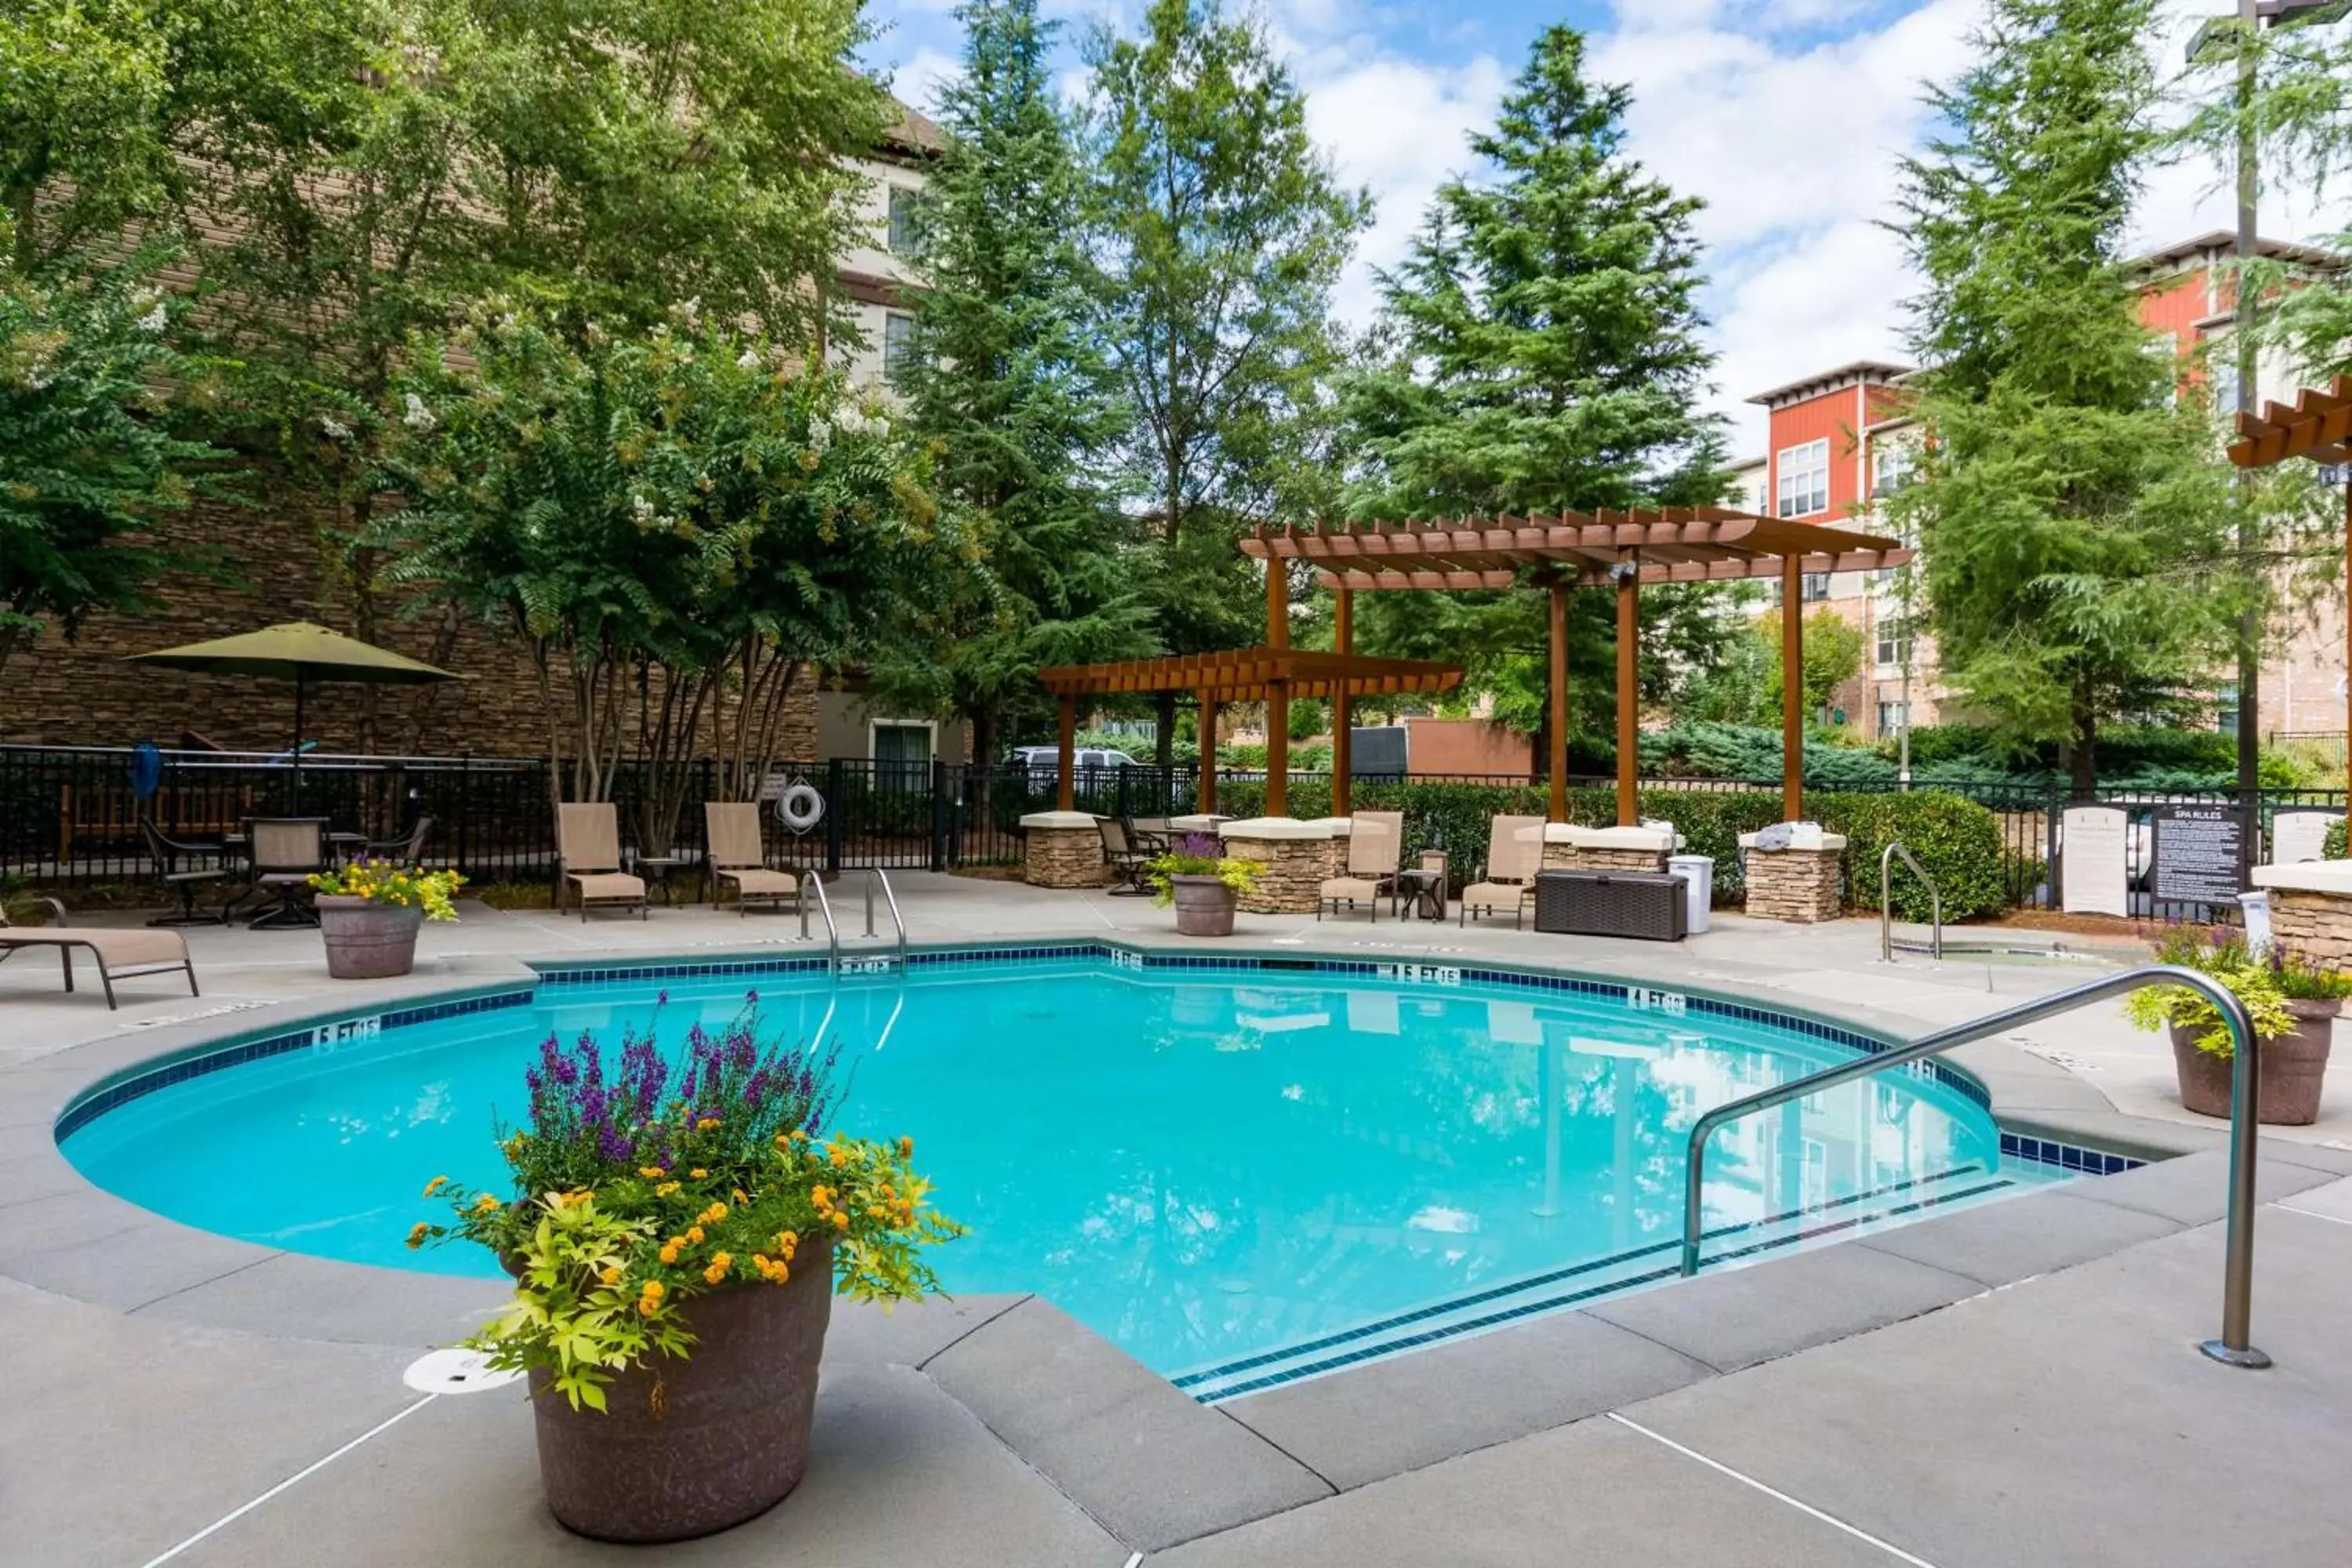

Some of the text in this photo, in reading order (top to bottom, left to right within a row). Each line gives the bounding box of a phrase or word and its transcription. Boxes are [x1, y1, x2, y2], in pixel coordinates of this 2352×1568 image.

[2174, 810, 2223, 820] SPA RULES
[1420, 966, 1439, 978] FT
[1649, 990, 1665, 1004] FT
[337, 1022, 358, 1041] FT
